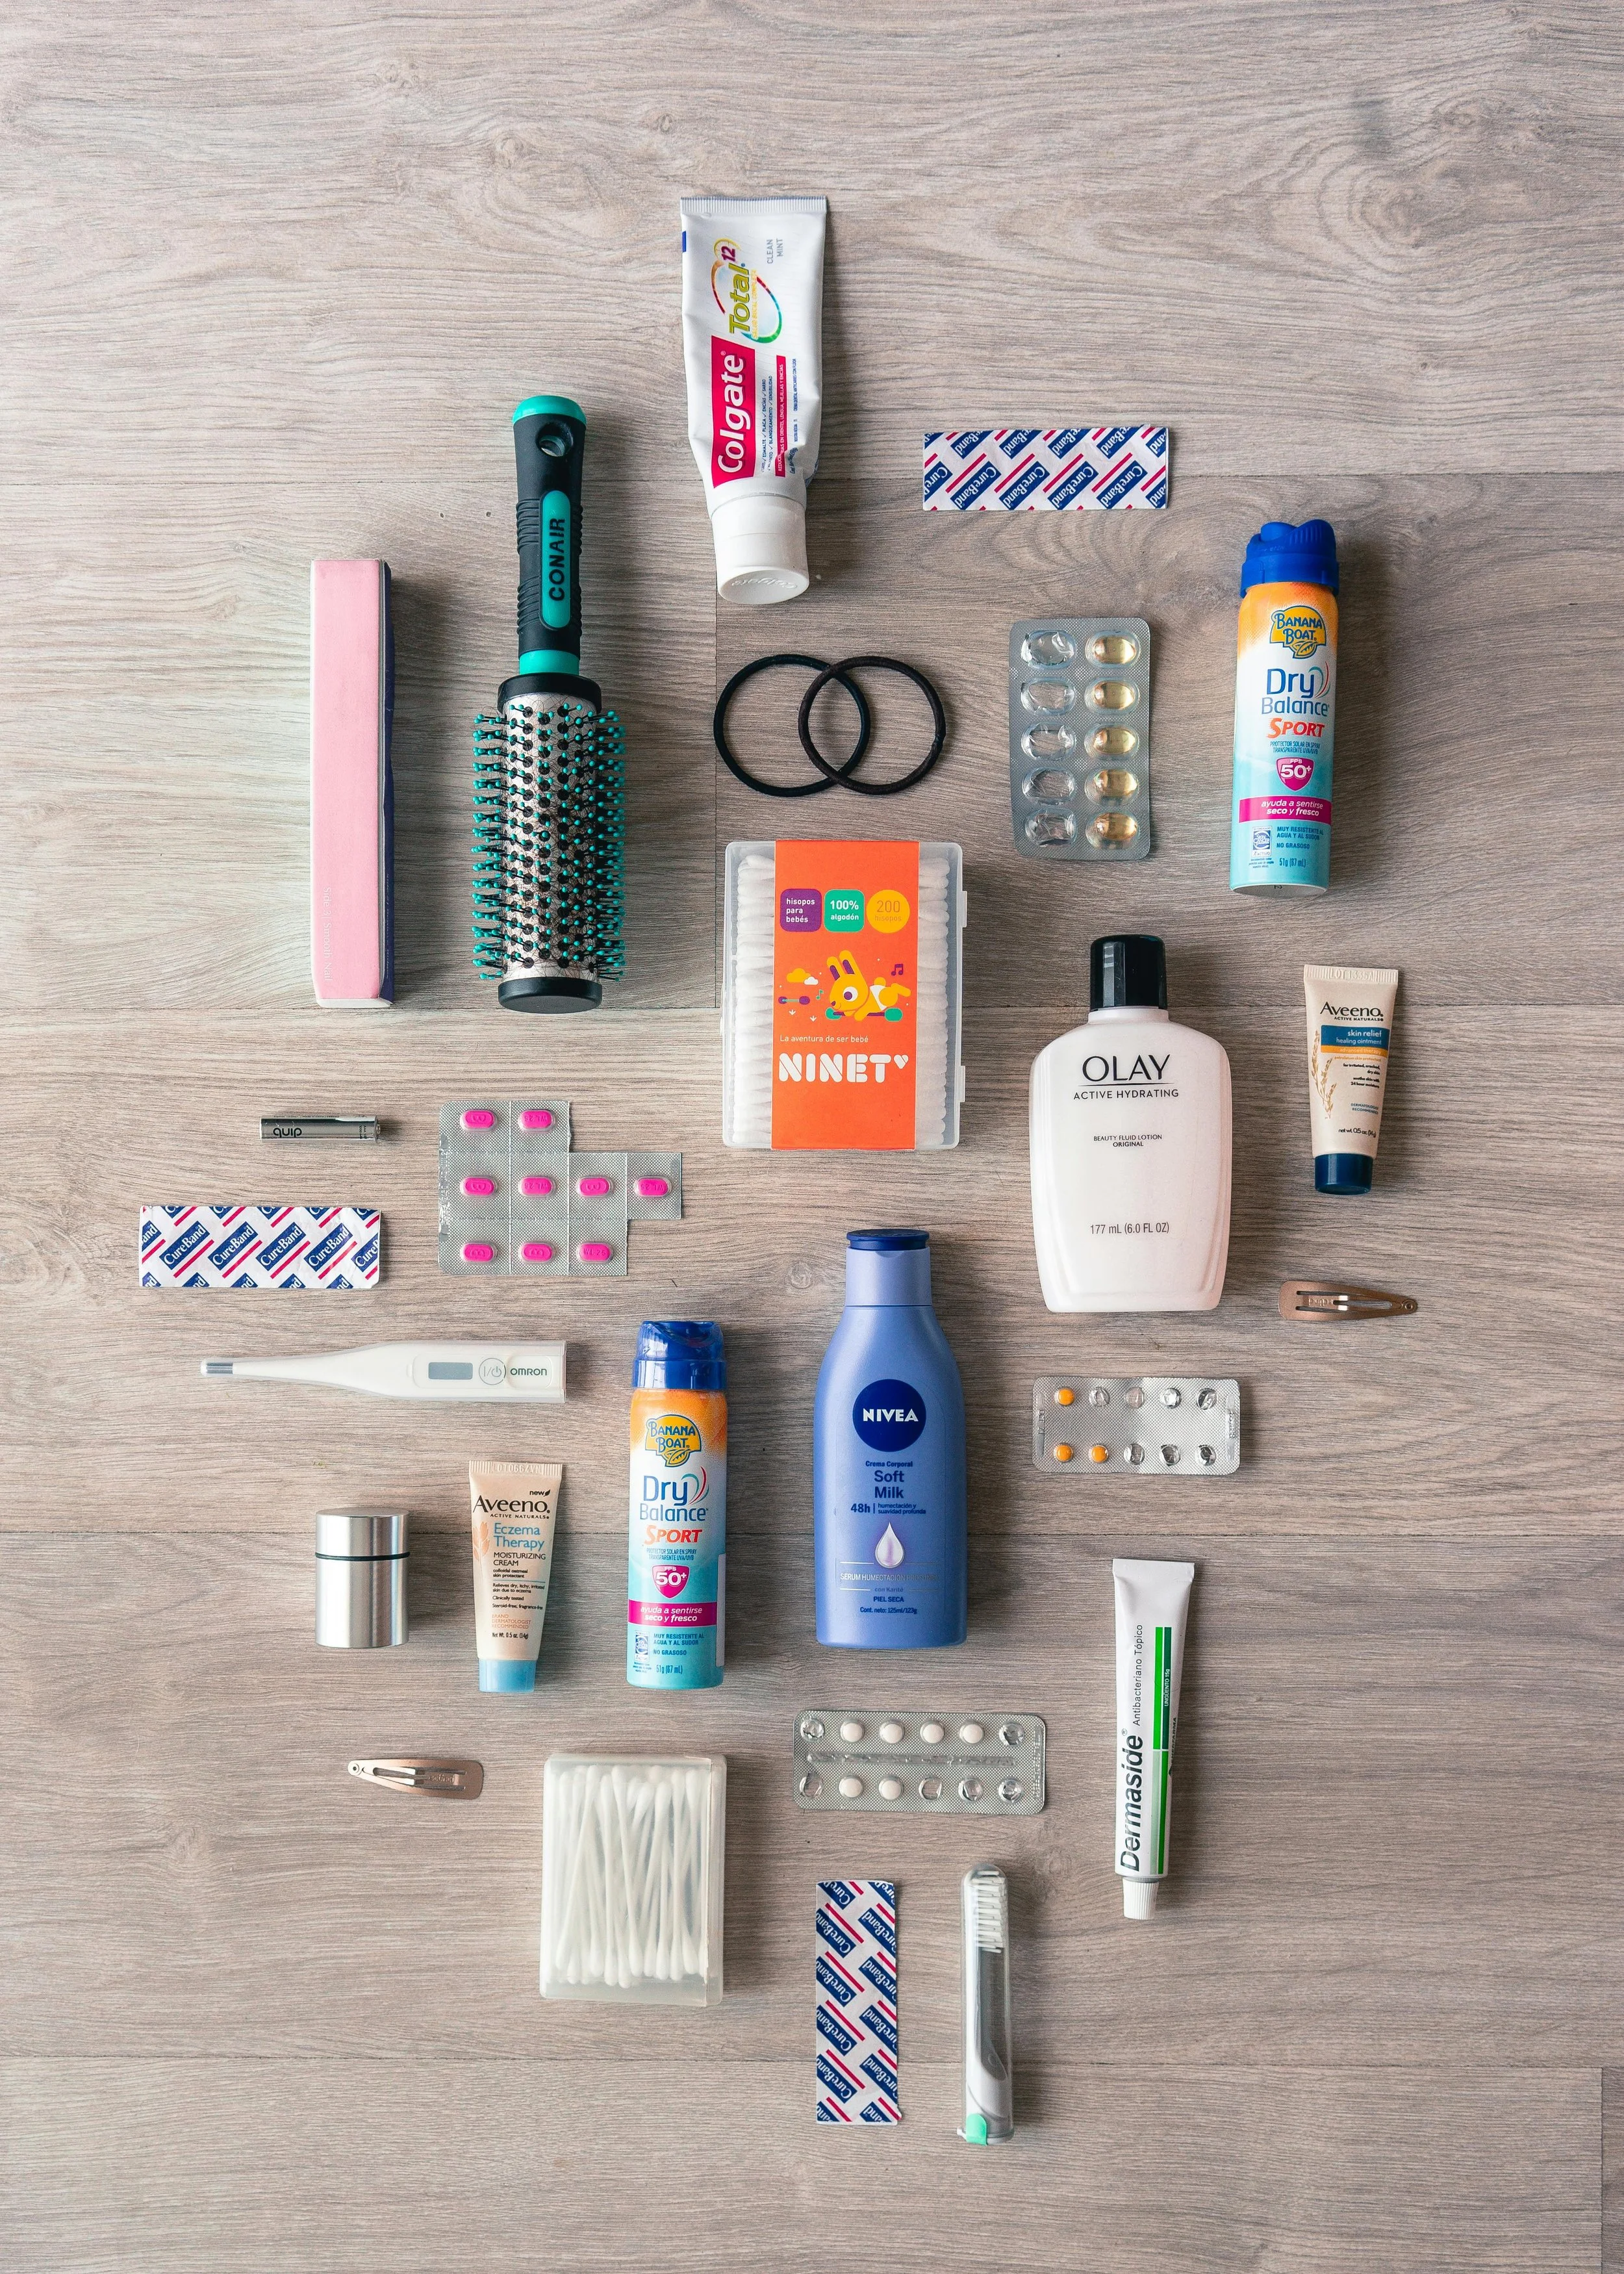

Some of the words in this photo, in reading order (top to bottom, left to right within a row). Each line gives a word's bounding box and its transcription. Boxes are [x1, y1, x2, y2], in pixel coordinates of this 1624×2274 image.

[721, 246, 735, 262] 12
[728, 262, 750, 334] Total
[717, 354, 750, 473] Colgate
[954, 466, 997, 508] CureBand
[1002, 466, 1045, 508] CureBand
[1051, 466, 1094, 508] CureBand
[1100, 465, 1143, 507] CureBand
[548, 518, 565, 602] CONAIR
[1275, 613, 1323, 630] BANANA
[1283, 628, 1315, 645] BOAT
[1267, 668, 1314, 698] Dry
[1262, 696, 1328, 716] Balance
[1267, 717, 1325, 739] SPORT
[1280, 764, 1312, 778] 50+
[1262, 799, 1287, 808] ayuda
[1296, 800, 1323, 810] sentirse
[1295, 807, 1319, 816] fresco
[1279, 858, 1288, 867] 51g
[324, 887, 332, 908] Side
[786, 897, 816, 906] hisopos
[830, 900, 859, 910] 100%
[876, 900, 900, 913] 200
[830, 913, 859, 922] algodón
[324, 923, 333, 958] Smooth
[324, 962, 333, 982] Nail
[1320, 1001, 1381, 1017] Aveeno
[1336, 1037, 1356, 1045] healing
[779, 1053, 892, 1083] NINET
[1082, 1054, 1171, 1082] OLAY
[1073, 1091, 1113, 1100] ACTIVE
[1117, 1089, 1179, 1099] HYDRATING
[273, 1127, 303, 1138] quip
[1091, 1224, 1106, 1234] 177
[1109, 1223, 1122, 1234] mL
[1124, 1222, 1141, 1234] (6.0
[1143, 1223, 1153, 1233] FL
[1156, 1221, 1169, 1234] OZ)
[164, 1224, 207, 1265] CureBand
[212, 1225, 255, 1266] CureBand
[260, 1225, 303, 1266] CureBand
[308, 1225, 350, 1266] CureBand
[511, 1368, 547, 1376] OMRON
[863, 1408, 919, 1423] NIVEA
[648, 1421, 696, 1438] BANANA
[656, 1437, 687, 1453] BOAT
[874, 1470, 905, 1483] Soft
[643, 1476, 688, 1506] Dry
[875, 1486, 904, 1499] Milk
[473, 1495, 548, 1513] Aveeno
[850, 1503, 870, 1513] 48h
[640, 1503, 706, 1522] Balance
[494, 1522, 541, 1535] Eczema
[644, 1524, 703, 1545] SPORT
[493, 1535, 545, 1552] Therapy
[655, 1572, 687, 1586] 50+
[862, 1573, 906, 1581] HUMECTACIÓN
[641, 1606, 662, 1615] ayuda
[1134, 1624, 1144, 1655] Tópico
[656, 1665, 665, 1674] 51g
[665, 1665, 674, 1674] (67
[1132, 1658, 1142, 1726] Antibacteriano
[1120, 1735, 1143, 1872] Dermaside
